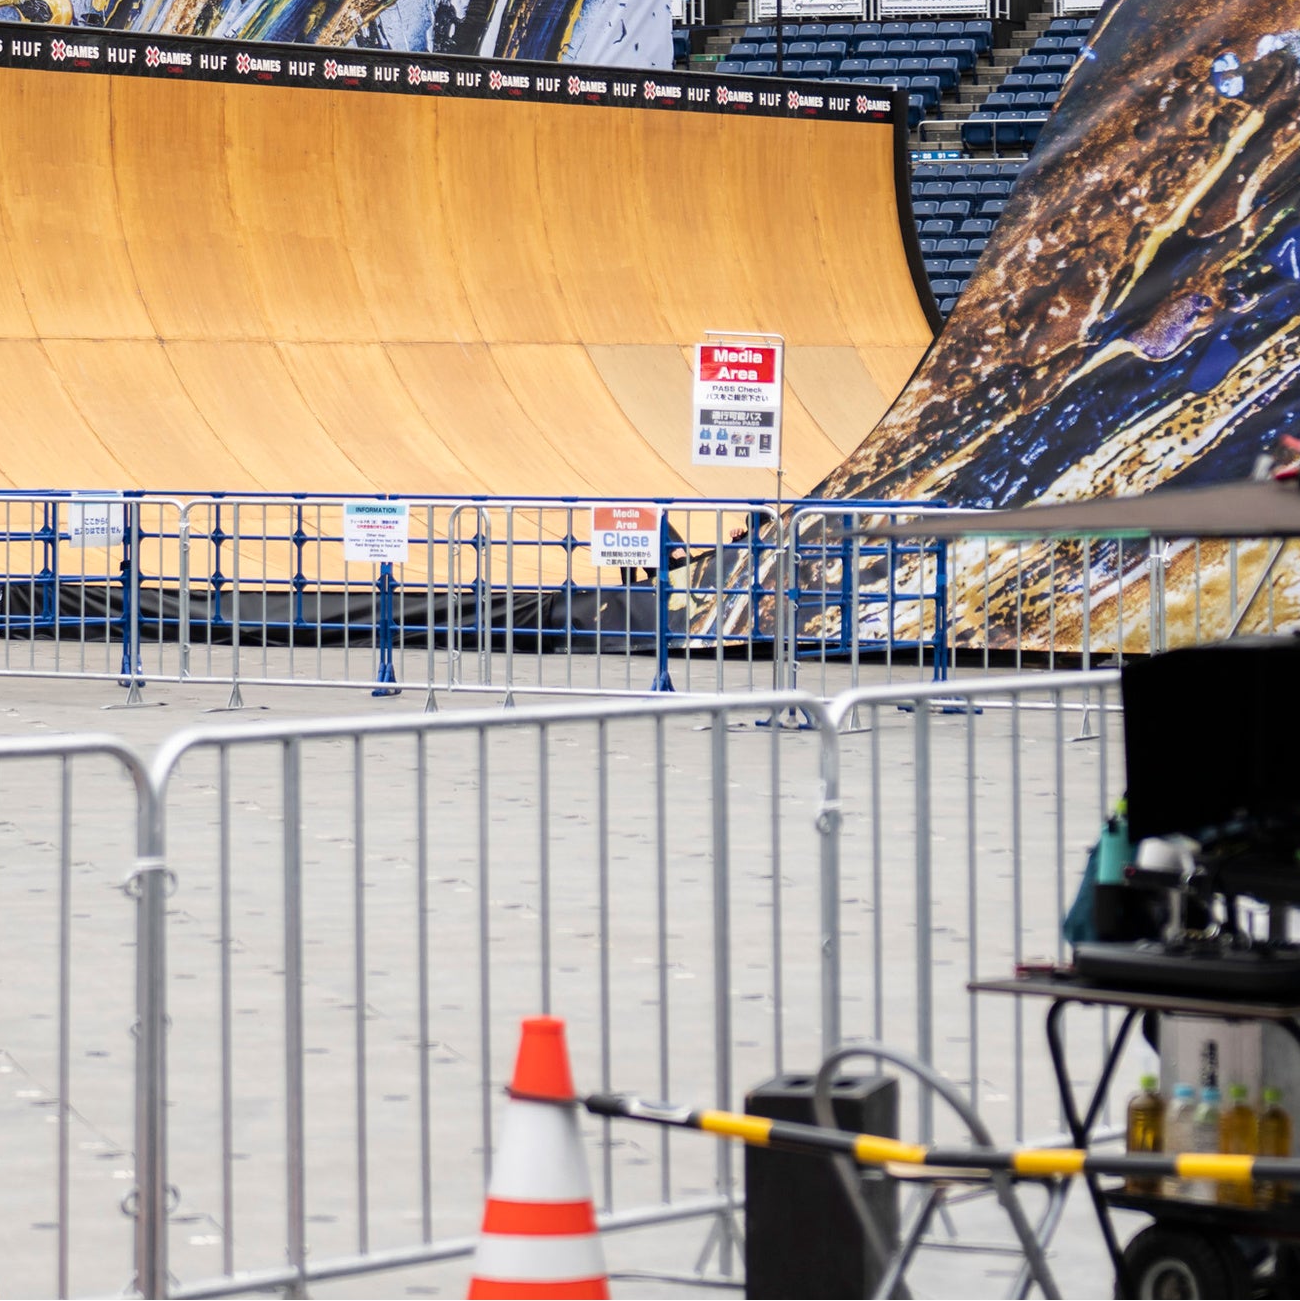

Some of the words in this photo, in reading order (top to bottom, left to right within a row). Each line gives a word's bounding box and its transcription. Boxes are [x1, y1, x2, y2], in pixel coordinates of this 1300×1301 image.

[12, 39, 40, 57] HUF
[66, 44, 99, 59] GAMES
[108, 47, 136, 64] HUF
[160, 51, 192, 66] GAMES
[200, 54, 227, 71] HUF
[250, 58, 281, 73] GAMES
[289, 60, 315, 77] HUF
[337, 64, 367, 78] GAMES
[374, 66, 400, 82] HUF
[714, 349, 763, 364] Media
[718, 367, 758, 380] Area
[738, 385, 762, 393] Check
[355, 506, 397, 514] INFORMATION
[612, 508, 640, 518] Media
[615, 520, 638, 530] Area
[603, 532, 650, 548] Close
